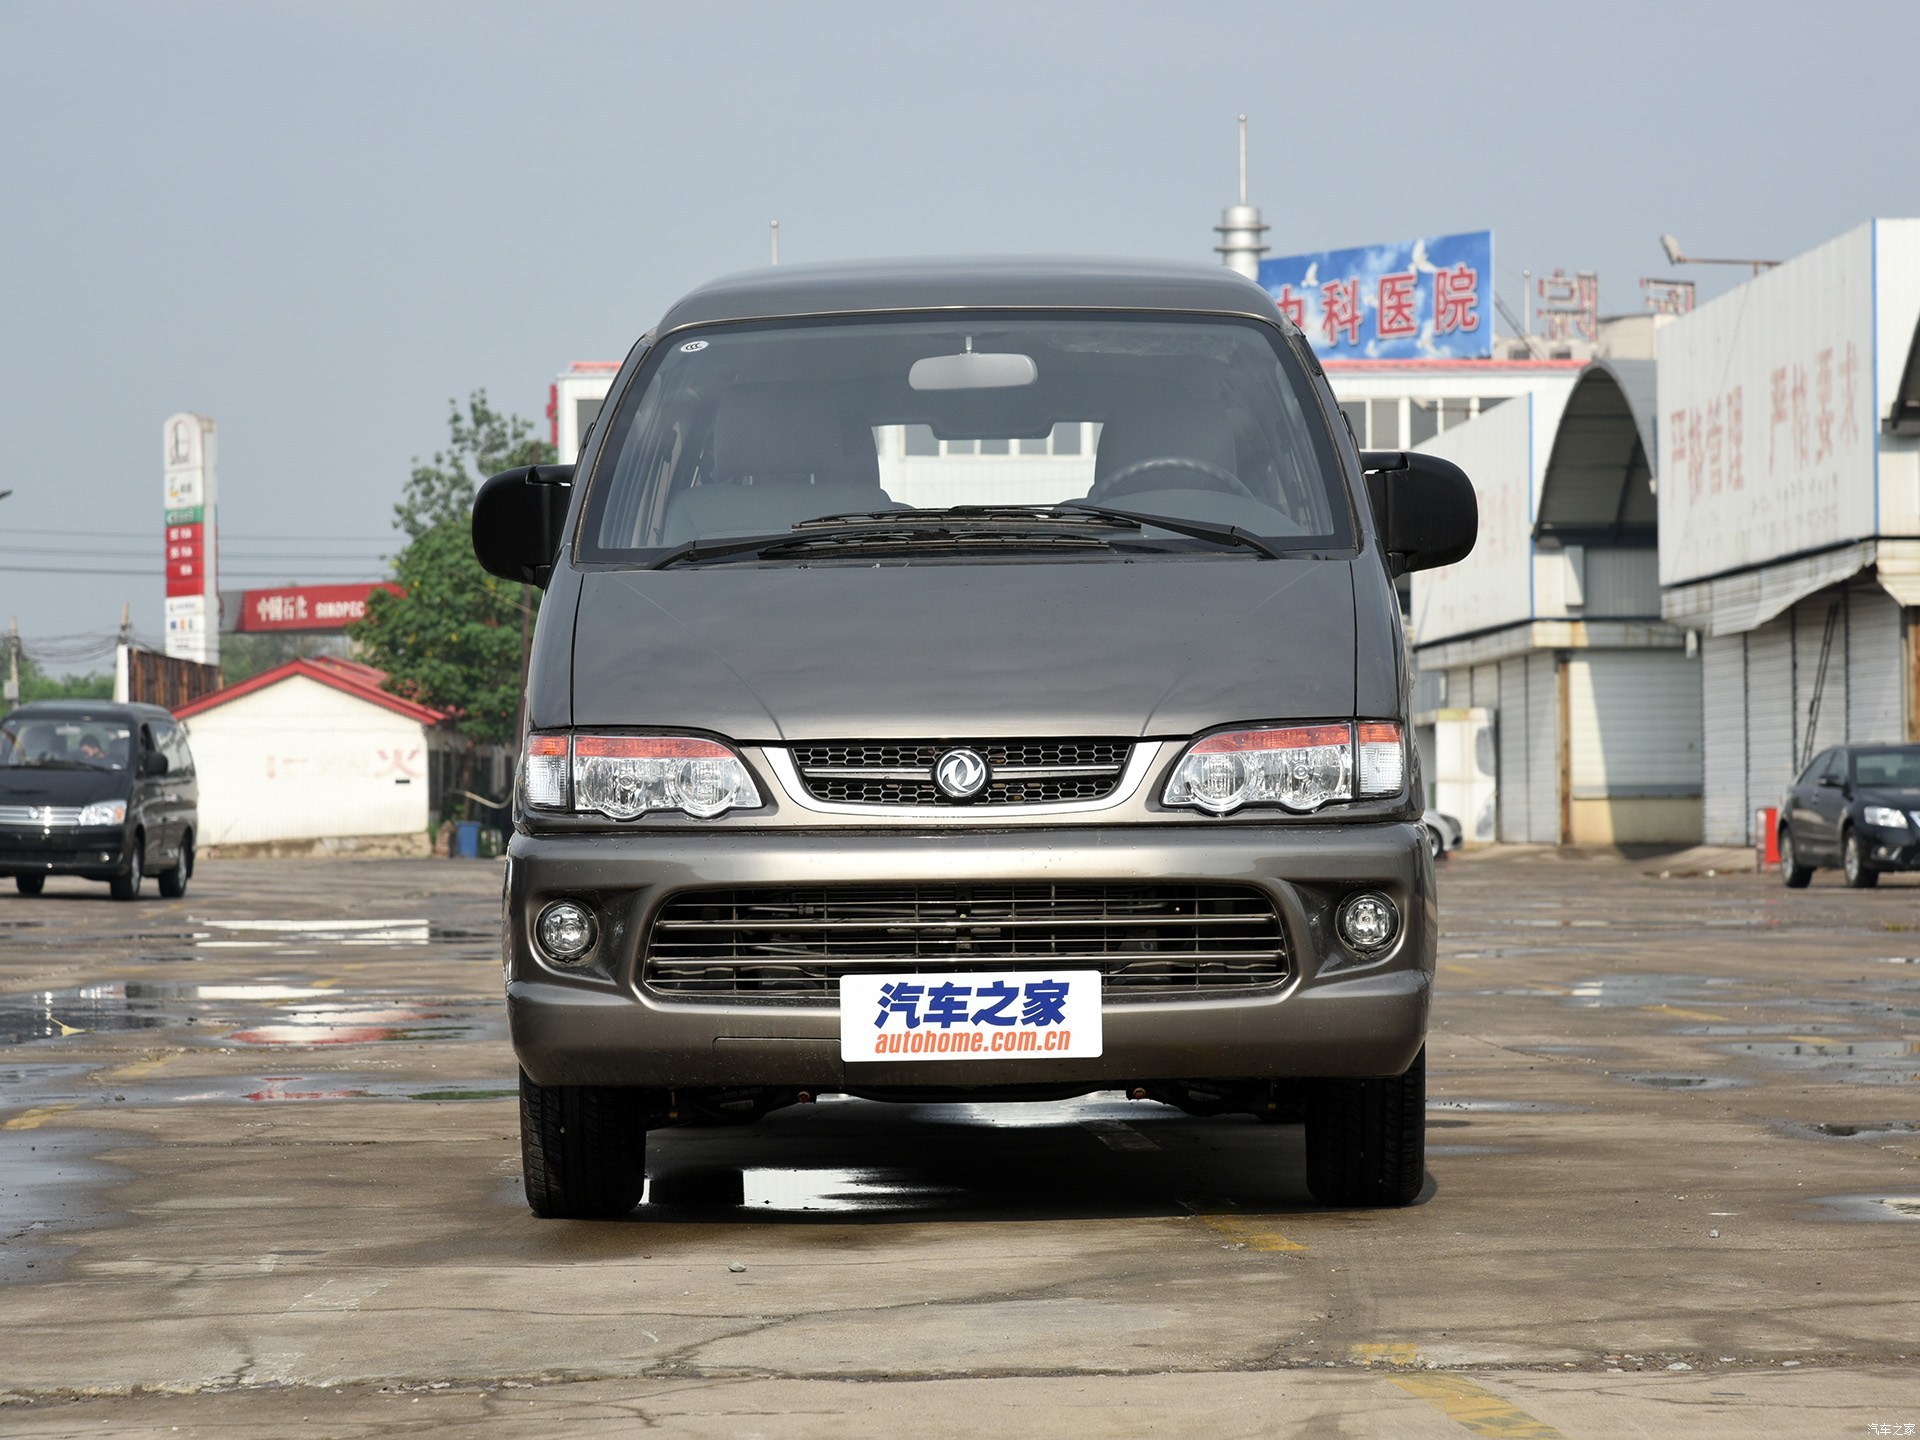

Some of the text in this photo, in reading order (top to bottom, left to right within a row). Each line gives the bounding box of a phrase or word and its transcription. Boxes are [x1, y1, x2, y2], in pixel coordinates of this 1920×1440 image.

[315, 600, 365, 619] SINOPEC
[873, 979, 1070, 1029] 汽车之家
[874, 1030, 1071, 1054] autohome.com.cn
